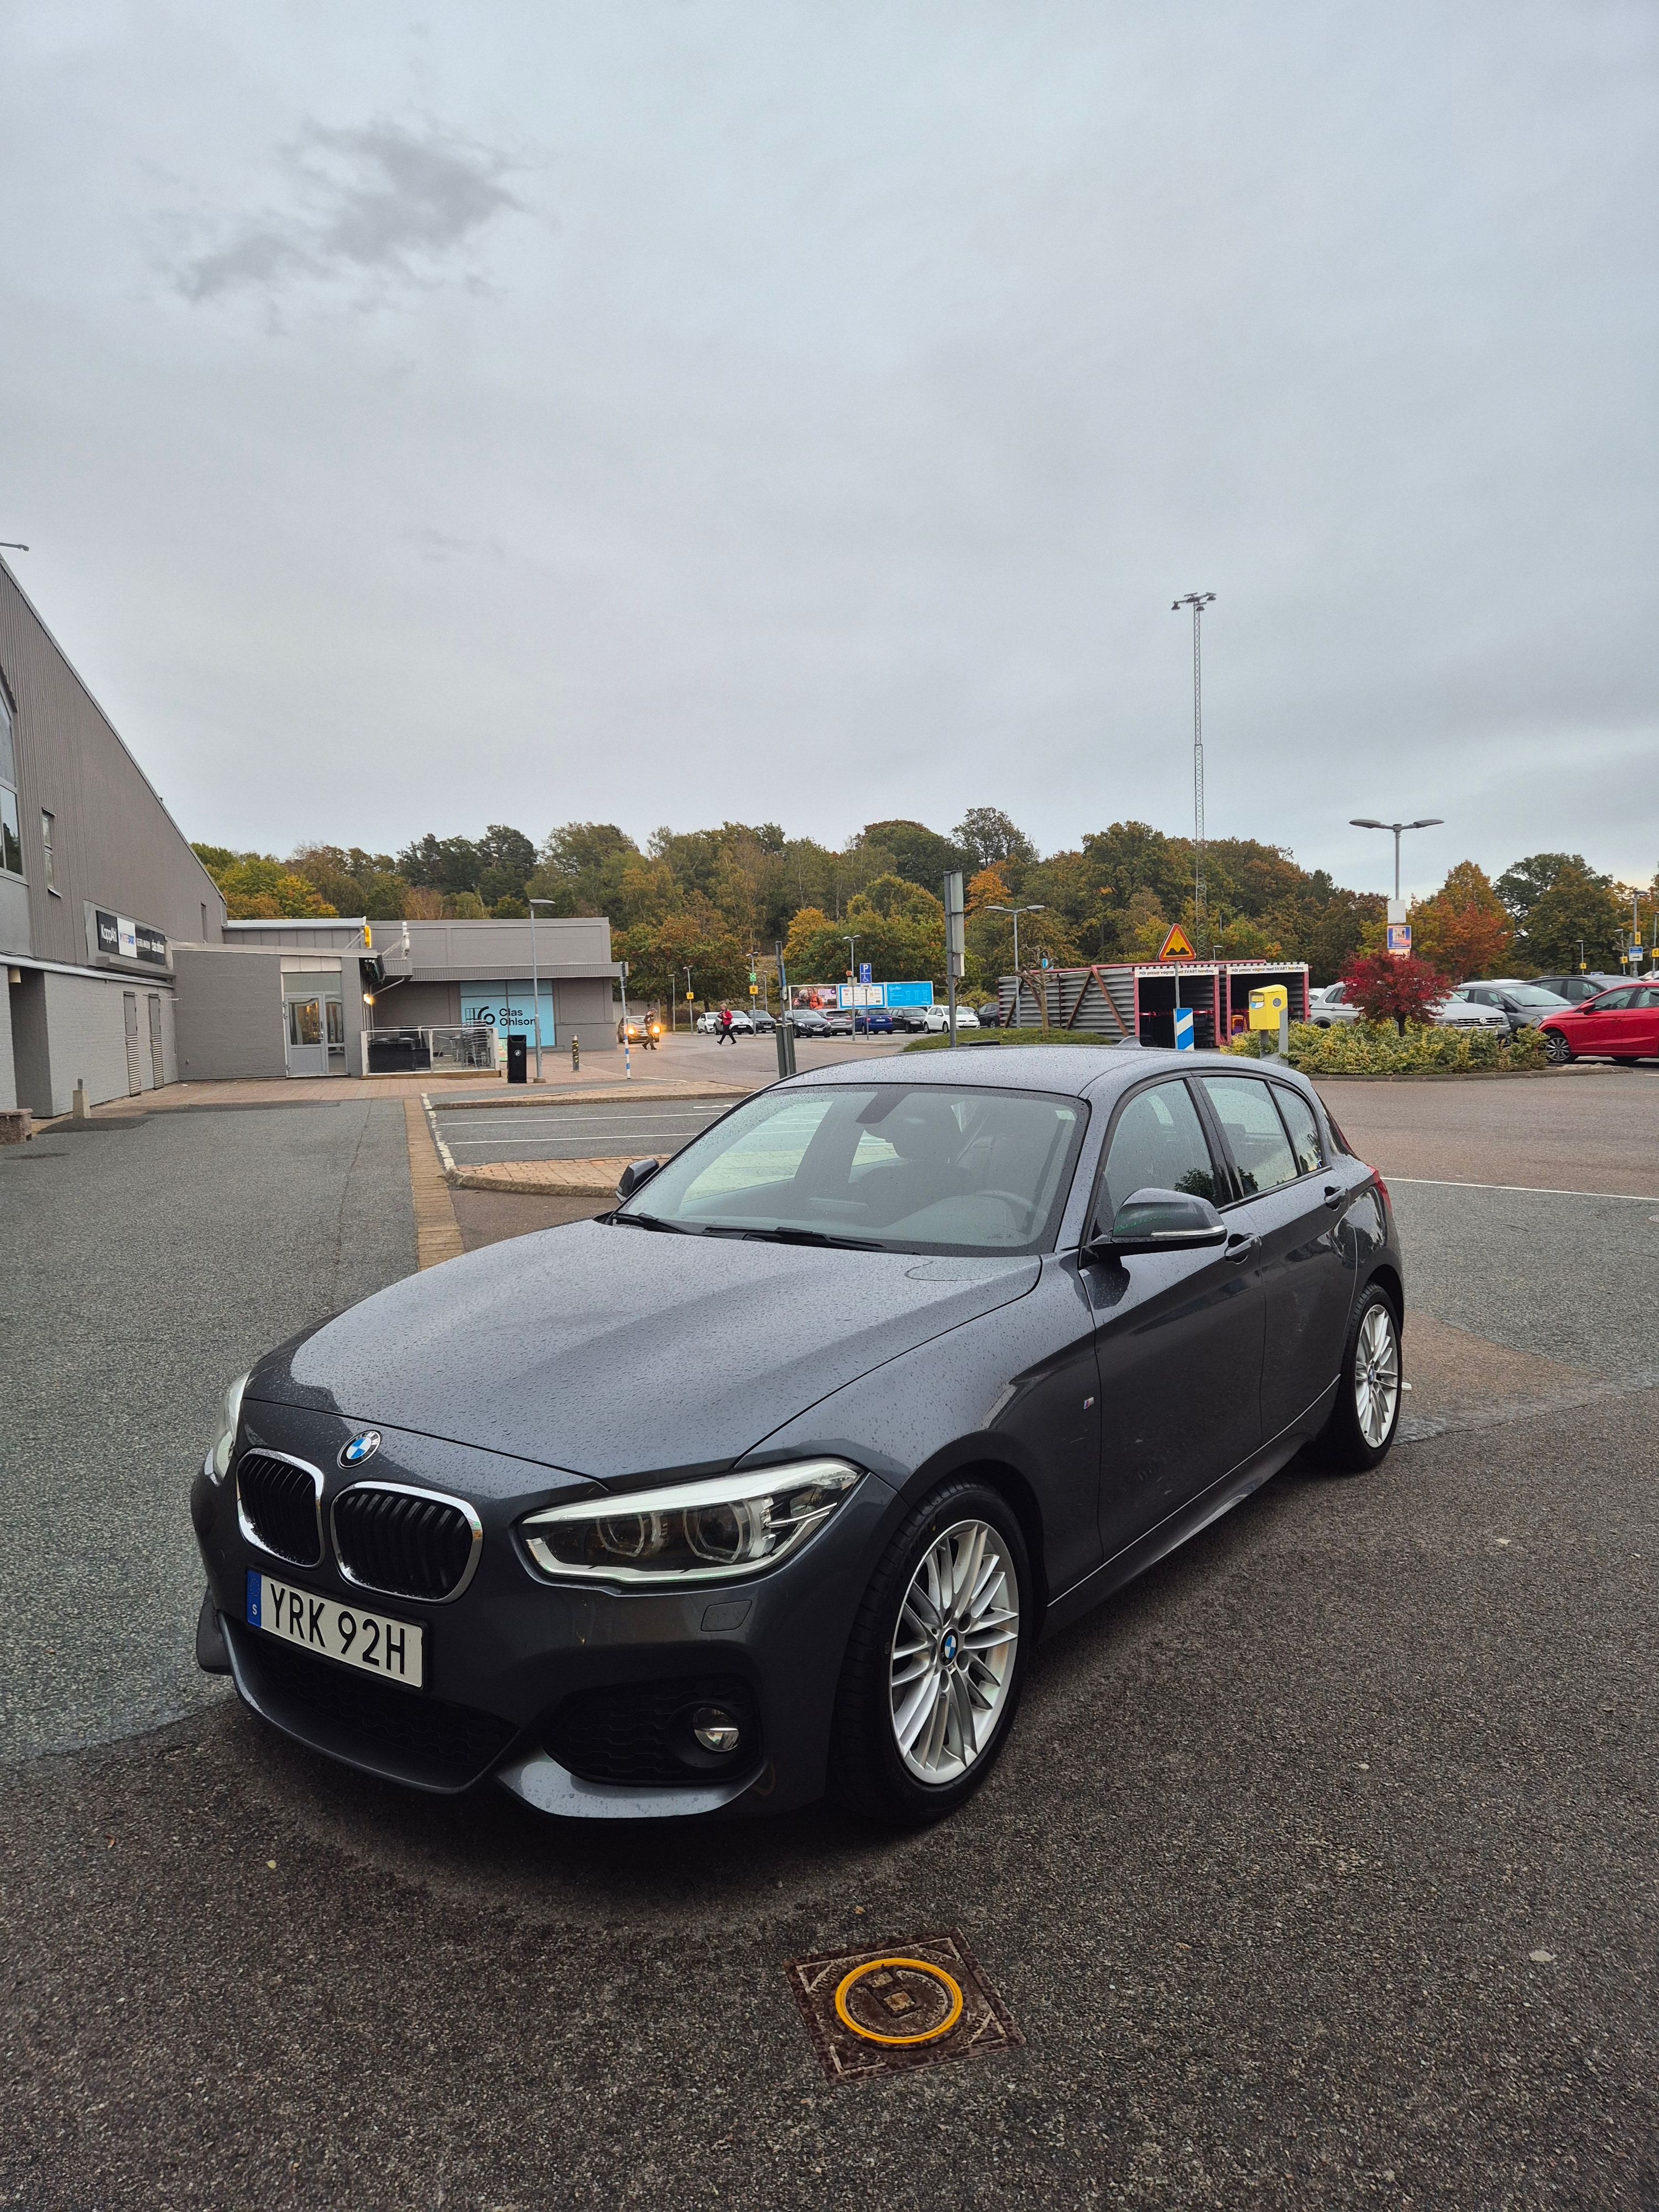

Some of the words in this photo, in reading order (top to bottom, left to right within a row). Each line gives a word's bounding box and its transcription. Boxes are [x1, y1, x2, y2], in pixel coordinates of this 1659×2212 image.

[863, 964, 869, 973] P
[499, 1008, 523, 1016] Clas
[252, 1604, 257, 1615] S
[270, 1583, 326, 1648] YRK
[338, 1610, 405, 1674] 92H
